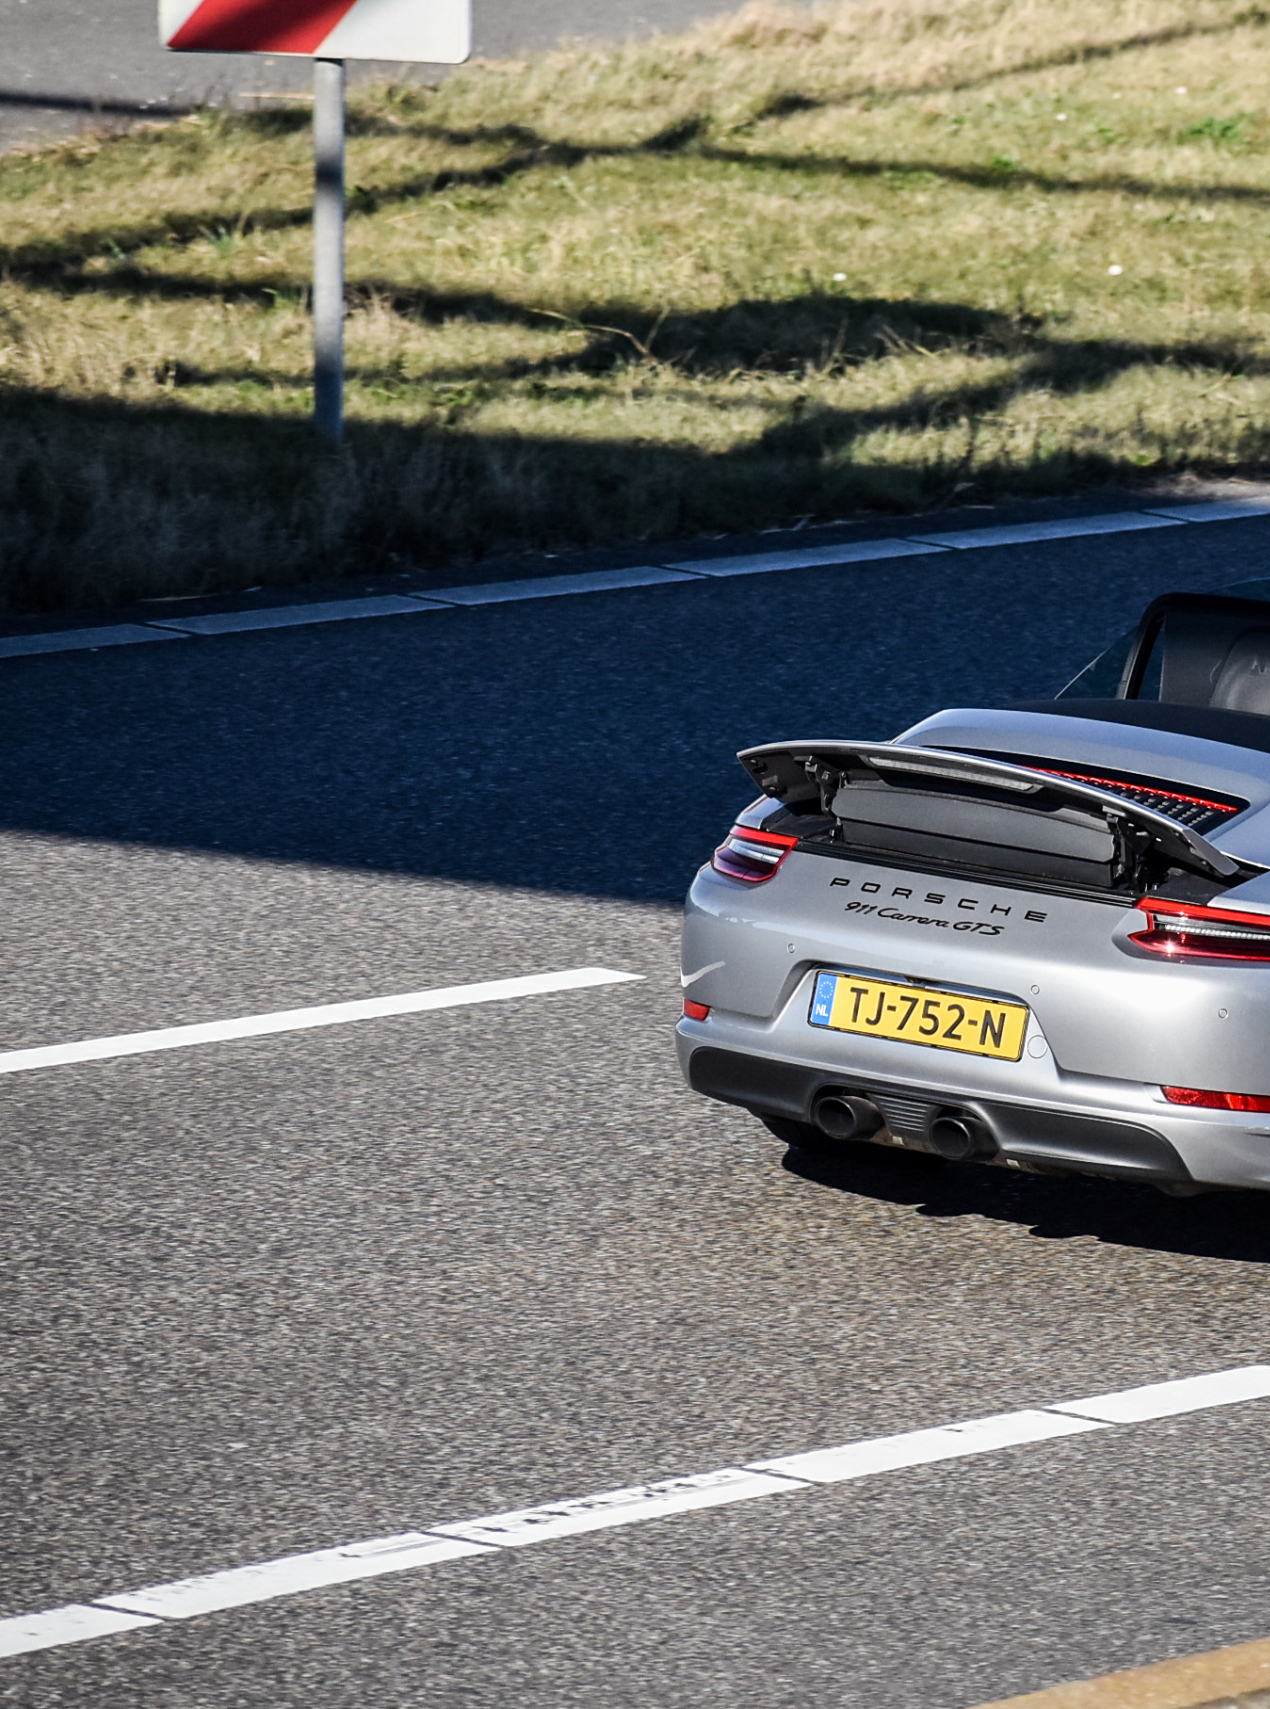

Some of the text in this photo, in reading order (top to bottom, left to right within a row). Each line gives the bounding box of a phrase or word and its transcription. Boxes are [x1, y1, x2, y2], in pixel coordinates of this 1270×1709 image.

[830, 877, 1048, 923] PORSCHE
[844, 901, 1006, 936] 911 Carrera GTS
[814, 1003, 829, 1017] NL
[850, 986, 1007, 1049] TJ-752-N
